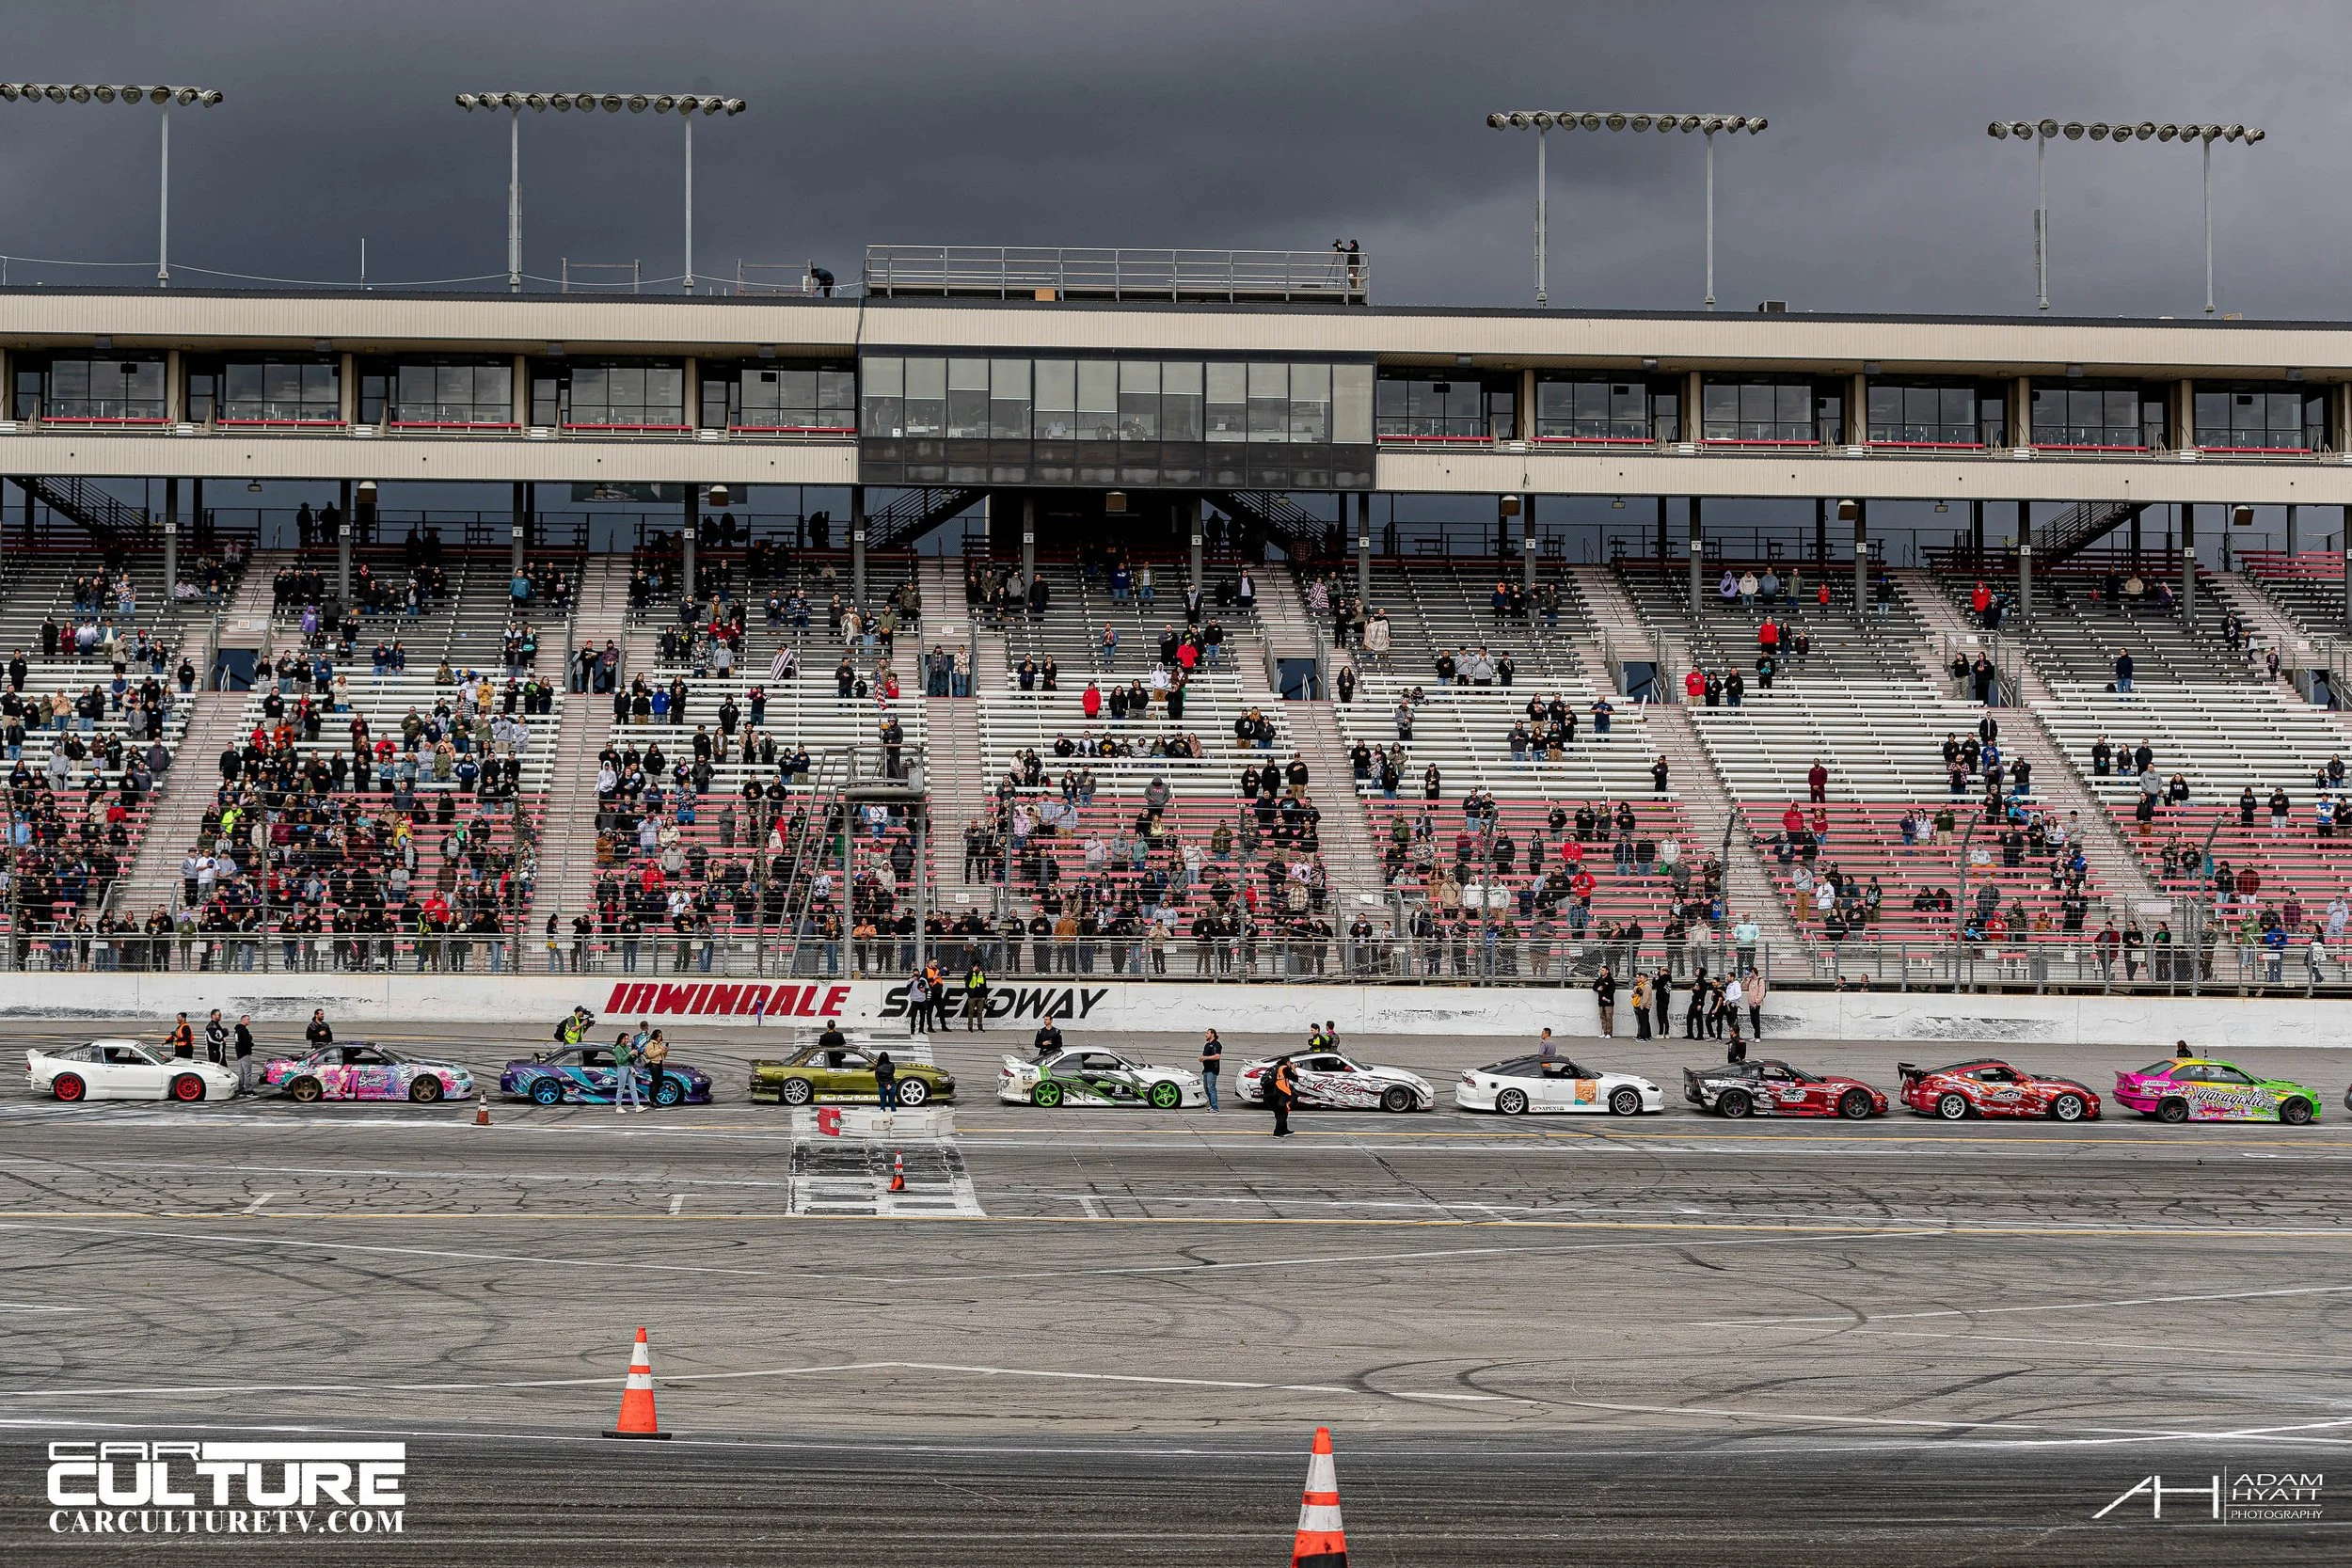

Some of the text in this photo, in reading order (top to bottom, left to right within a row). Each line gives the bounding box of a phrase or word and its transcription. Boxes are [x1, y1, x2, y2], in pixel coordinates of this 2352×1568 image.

[604, 982, 1110, 1020] IRWINDALE SEDWAY
[2195, 1089, 2265, 1109] garagistic
